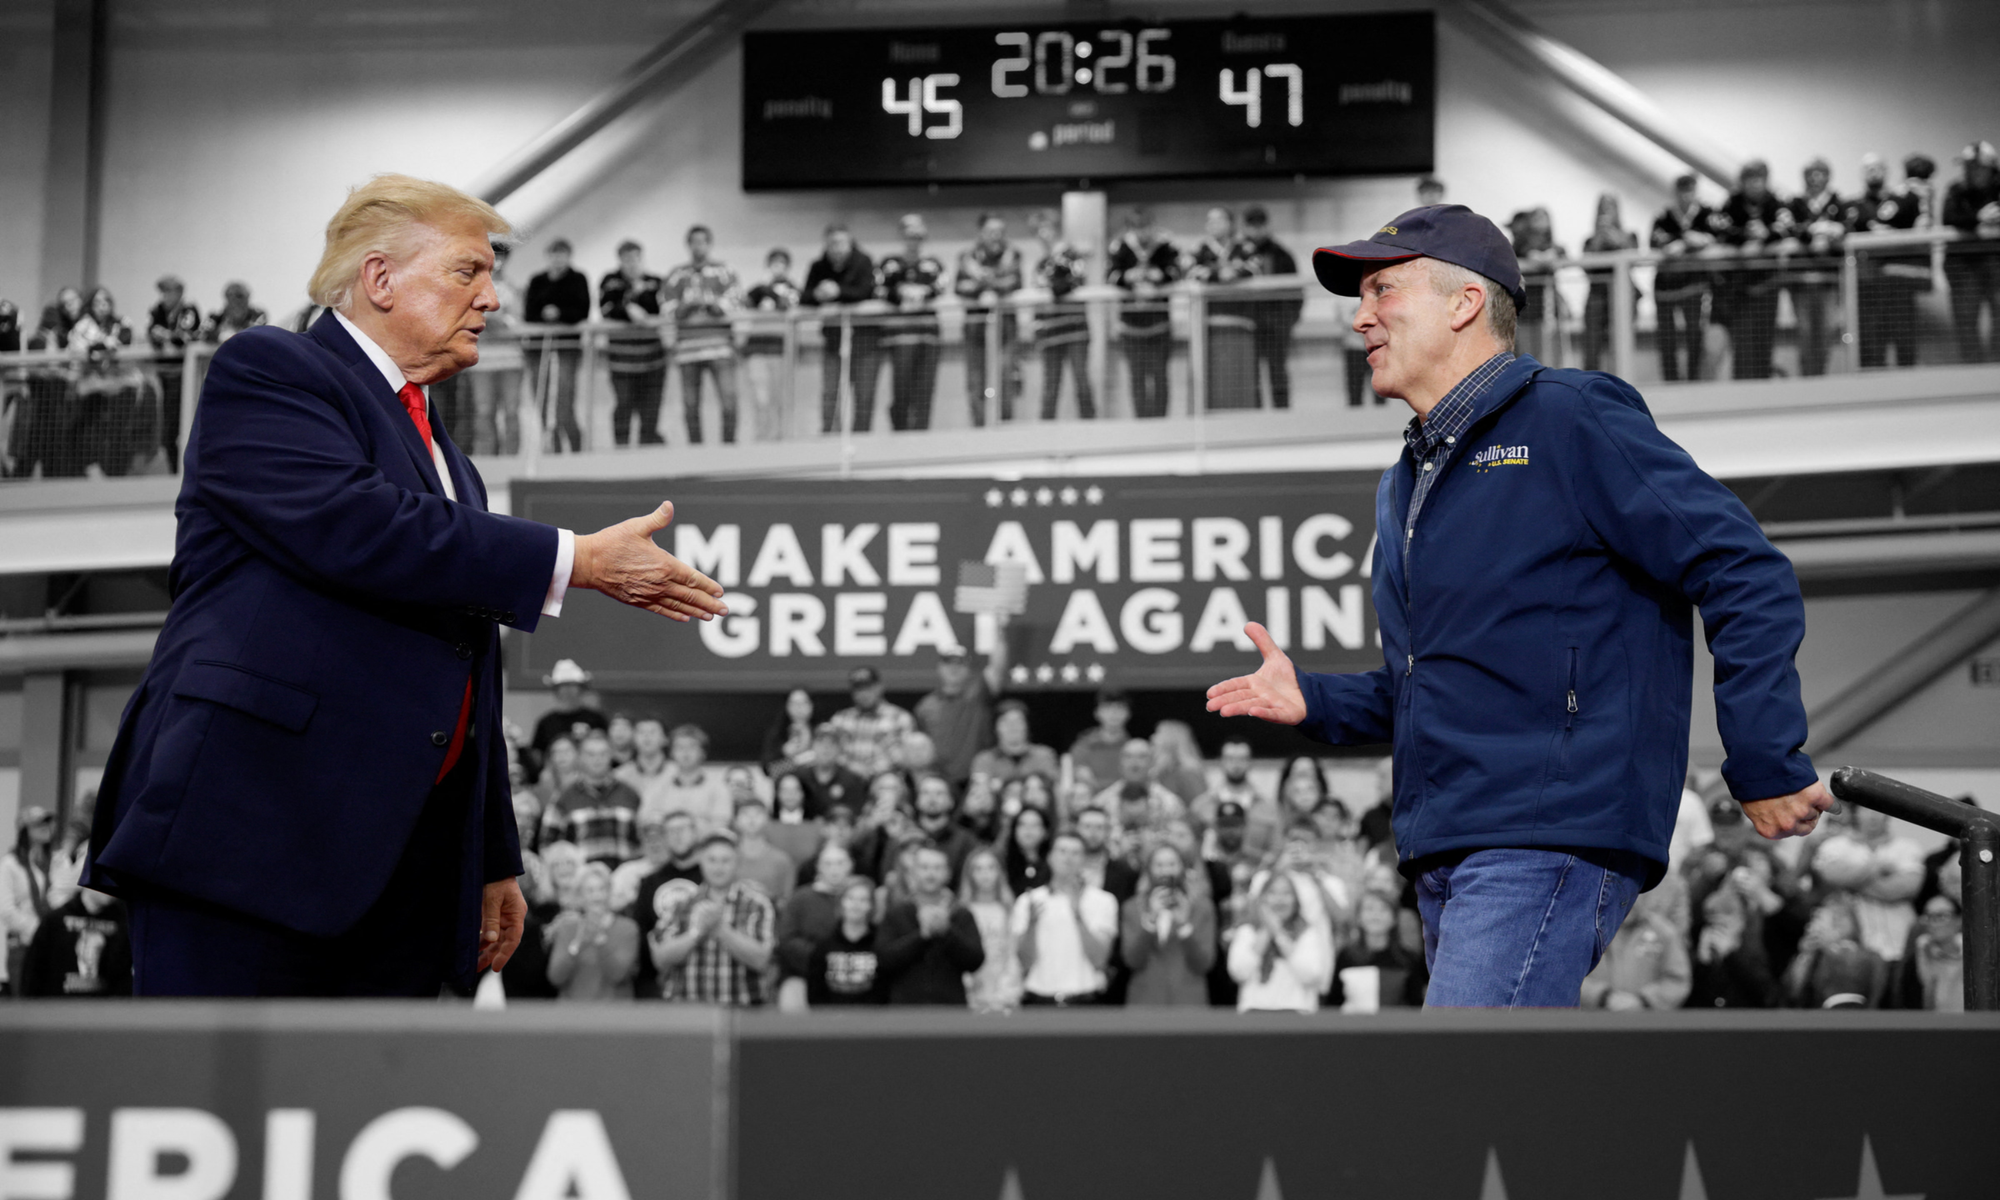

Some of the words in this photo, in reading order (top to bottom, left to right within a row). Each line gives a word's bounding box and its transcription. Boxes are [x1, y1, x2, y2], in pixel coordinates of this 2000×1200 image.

[990, 28, 1176, 98] 20:26
[1219, 63, 1303, 128] 47
[881, 73, 963, 140] 45
[1472, 444, 1530, 464] Sullivan
[674, 522, 941, 588] MAKE
